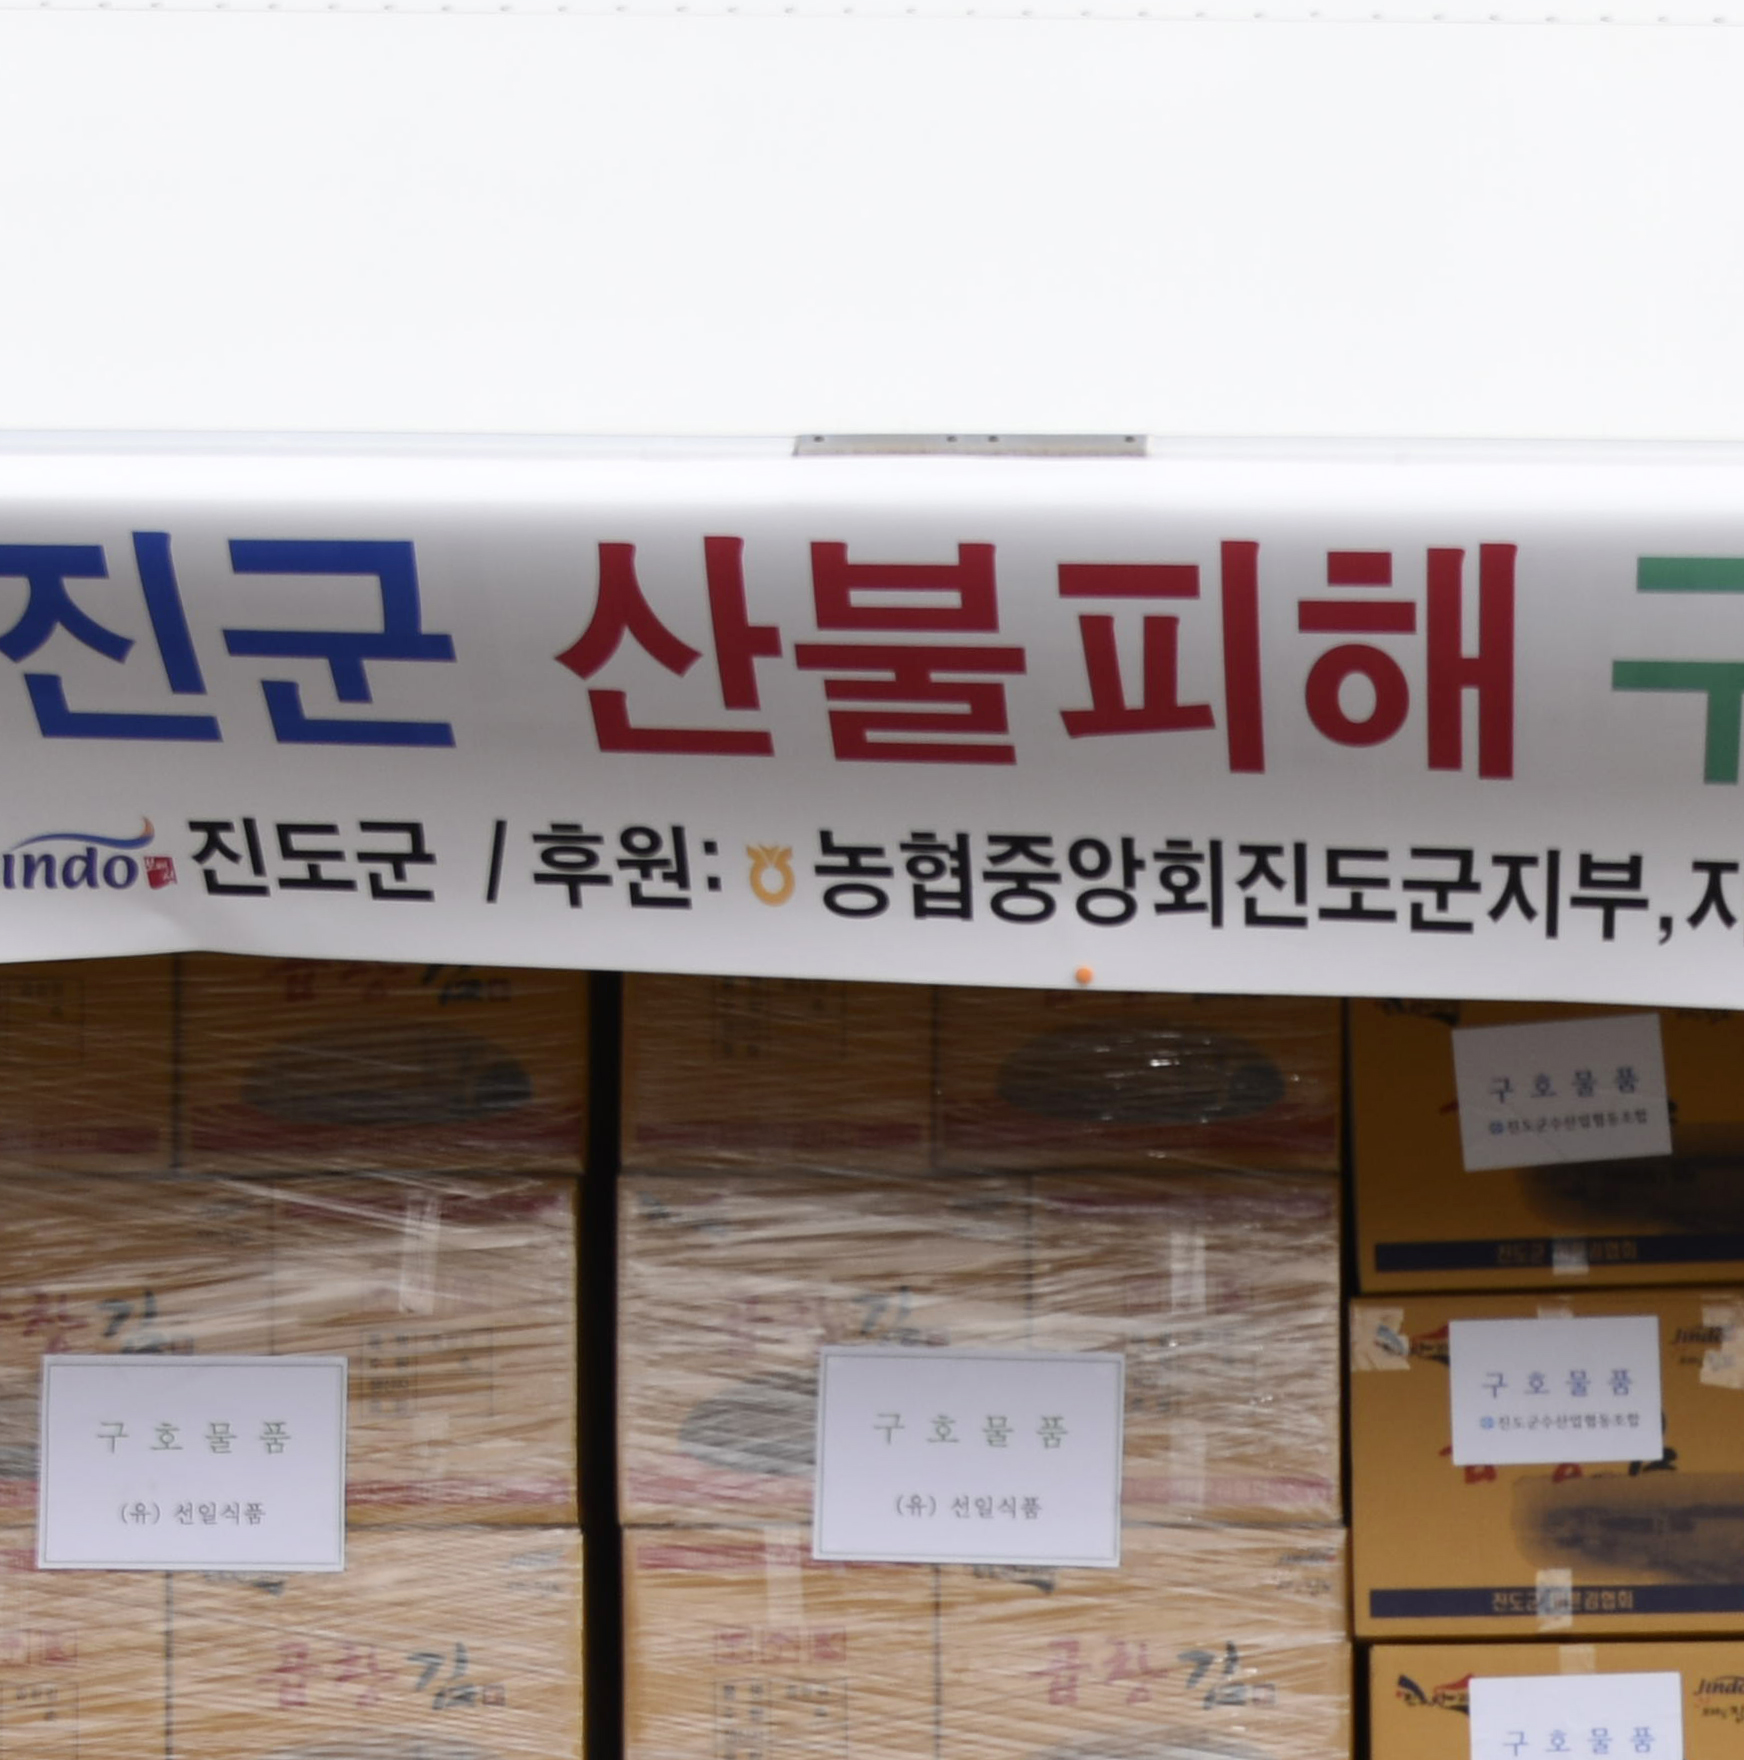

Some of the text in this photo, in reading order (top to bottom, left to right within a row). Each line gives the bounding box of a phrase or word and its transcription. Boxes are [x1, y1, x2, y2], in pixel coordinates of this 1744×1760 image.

[555, 535, 1517, 779] 산불피해
[189, 817, 437, 902] 진도군
[531, 820, 723, 908] 후원:
[120, 1502, 266, 1528] (유) 선일식품
[896, 1494, 1043, 1520] (유) 선일식품
